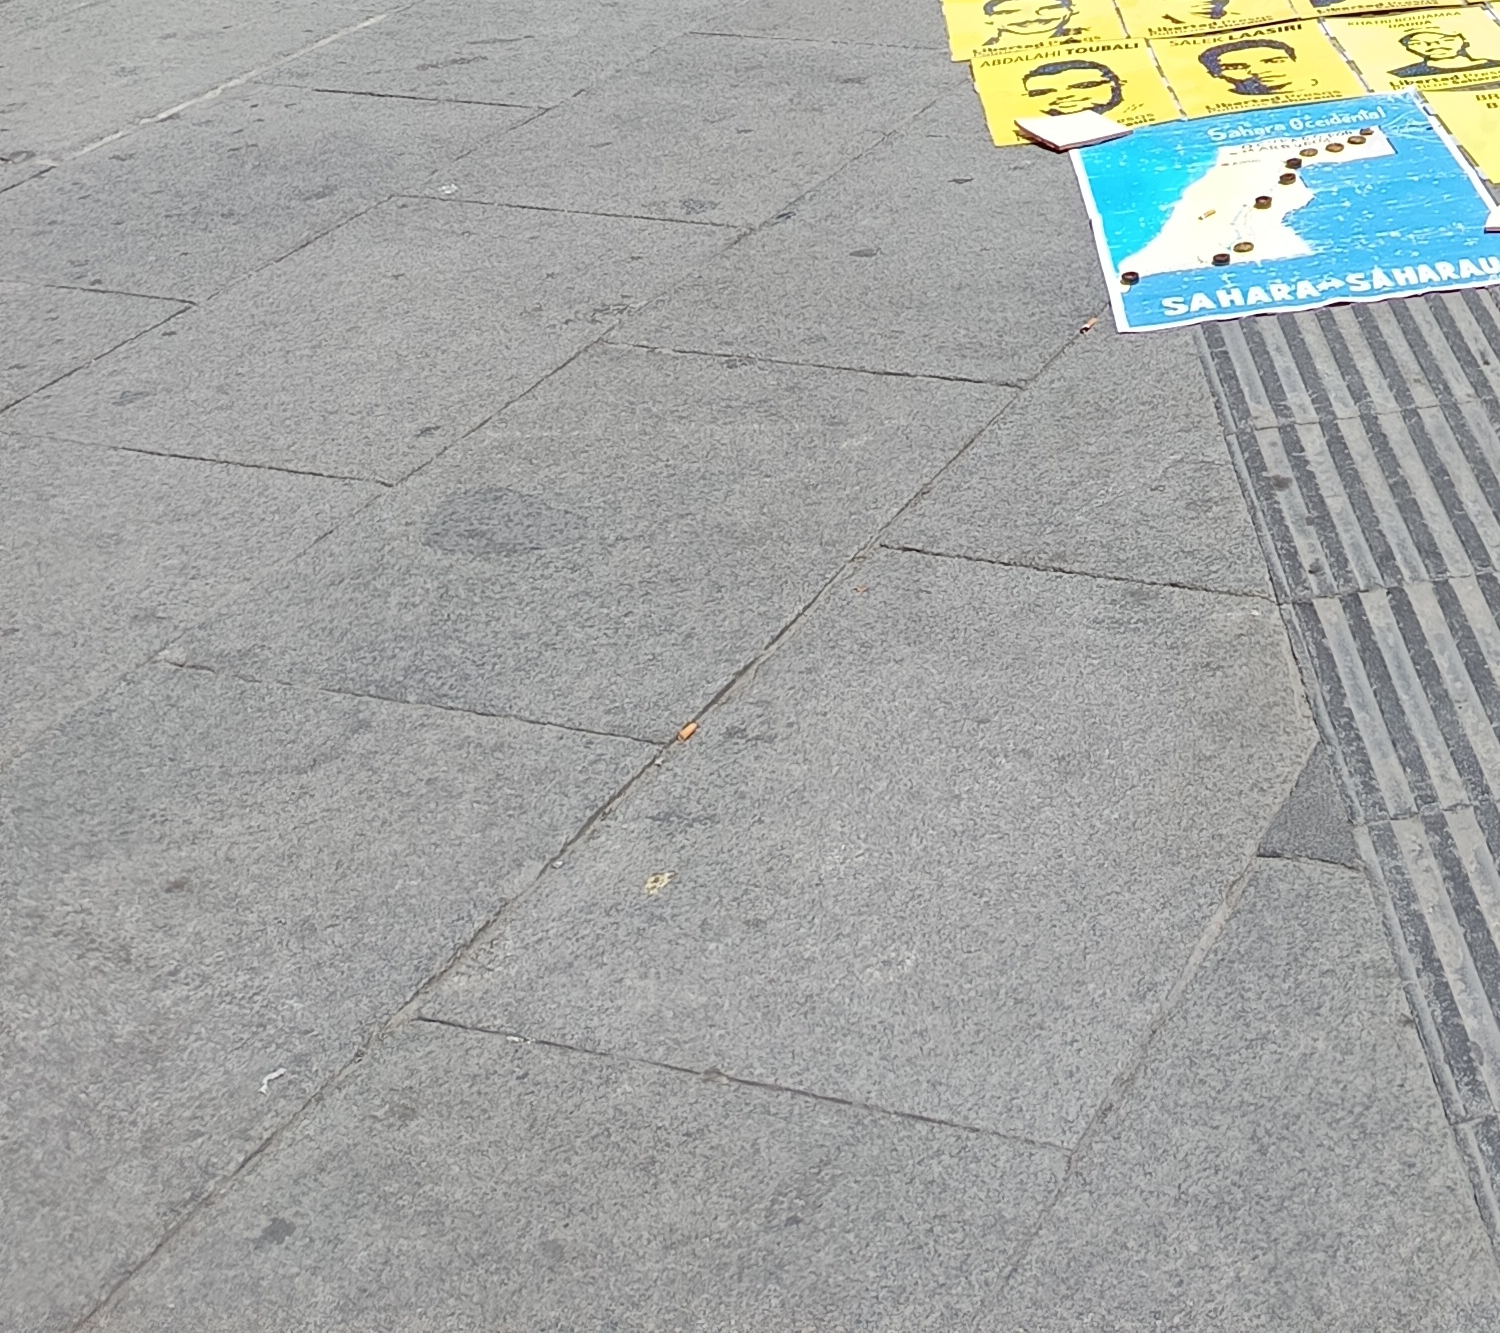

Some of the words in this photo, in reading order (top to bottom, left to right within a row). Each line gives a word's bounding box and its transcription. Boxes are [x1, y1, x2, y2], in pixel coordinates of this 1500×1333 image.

[980, 50, 1061, 68] ABDALAHI
[1065, 42, 1140, 56] TOUBALI
[1161, 279, 1321, 318] SAHARA
